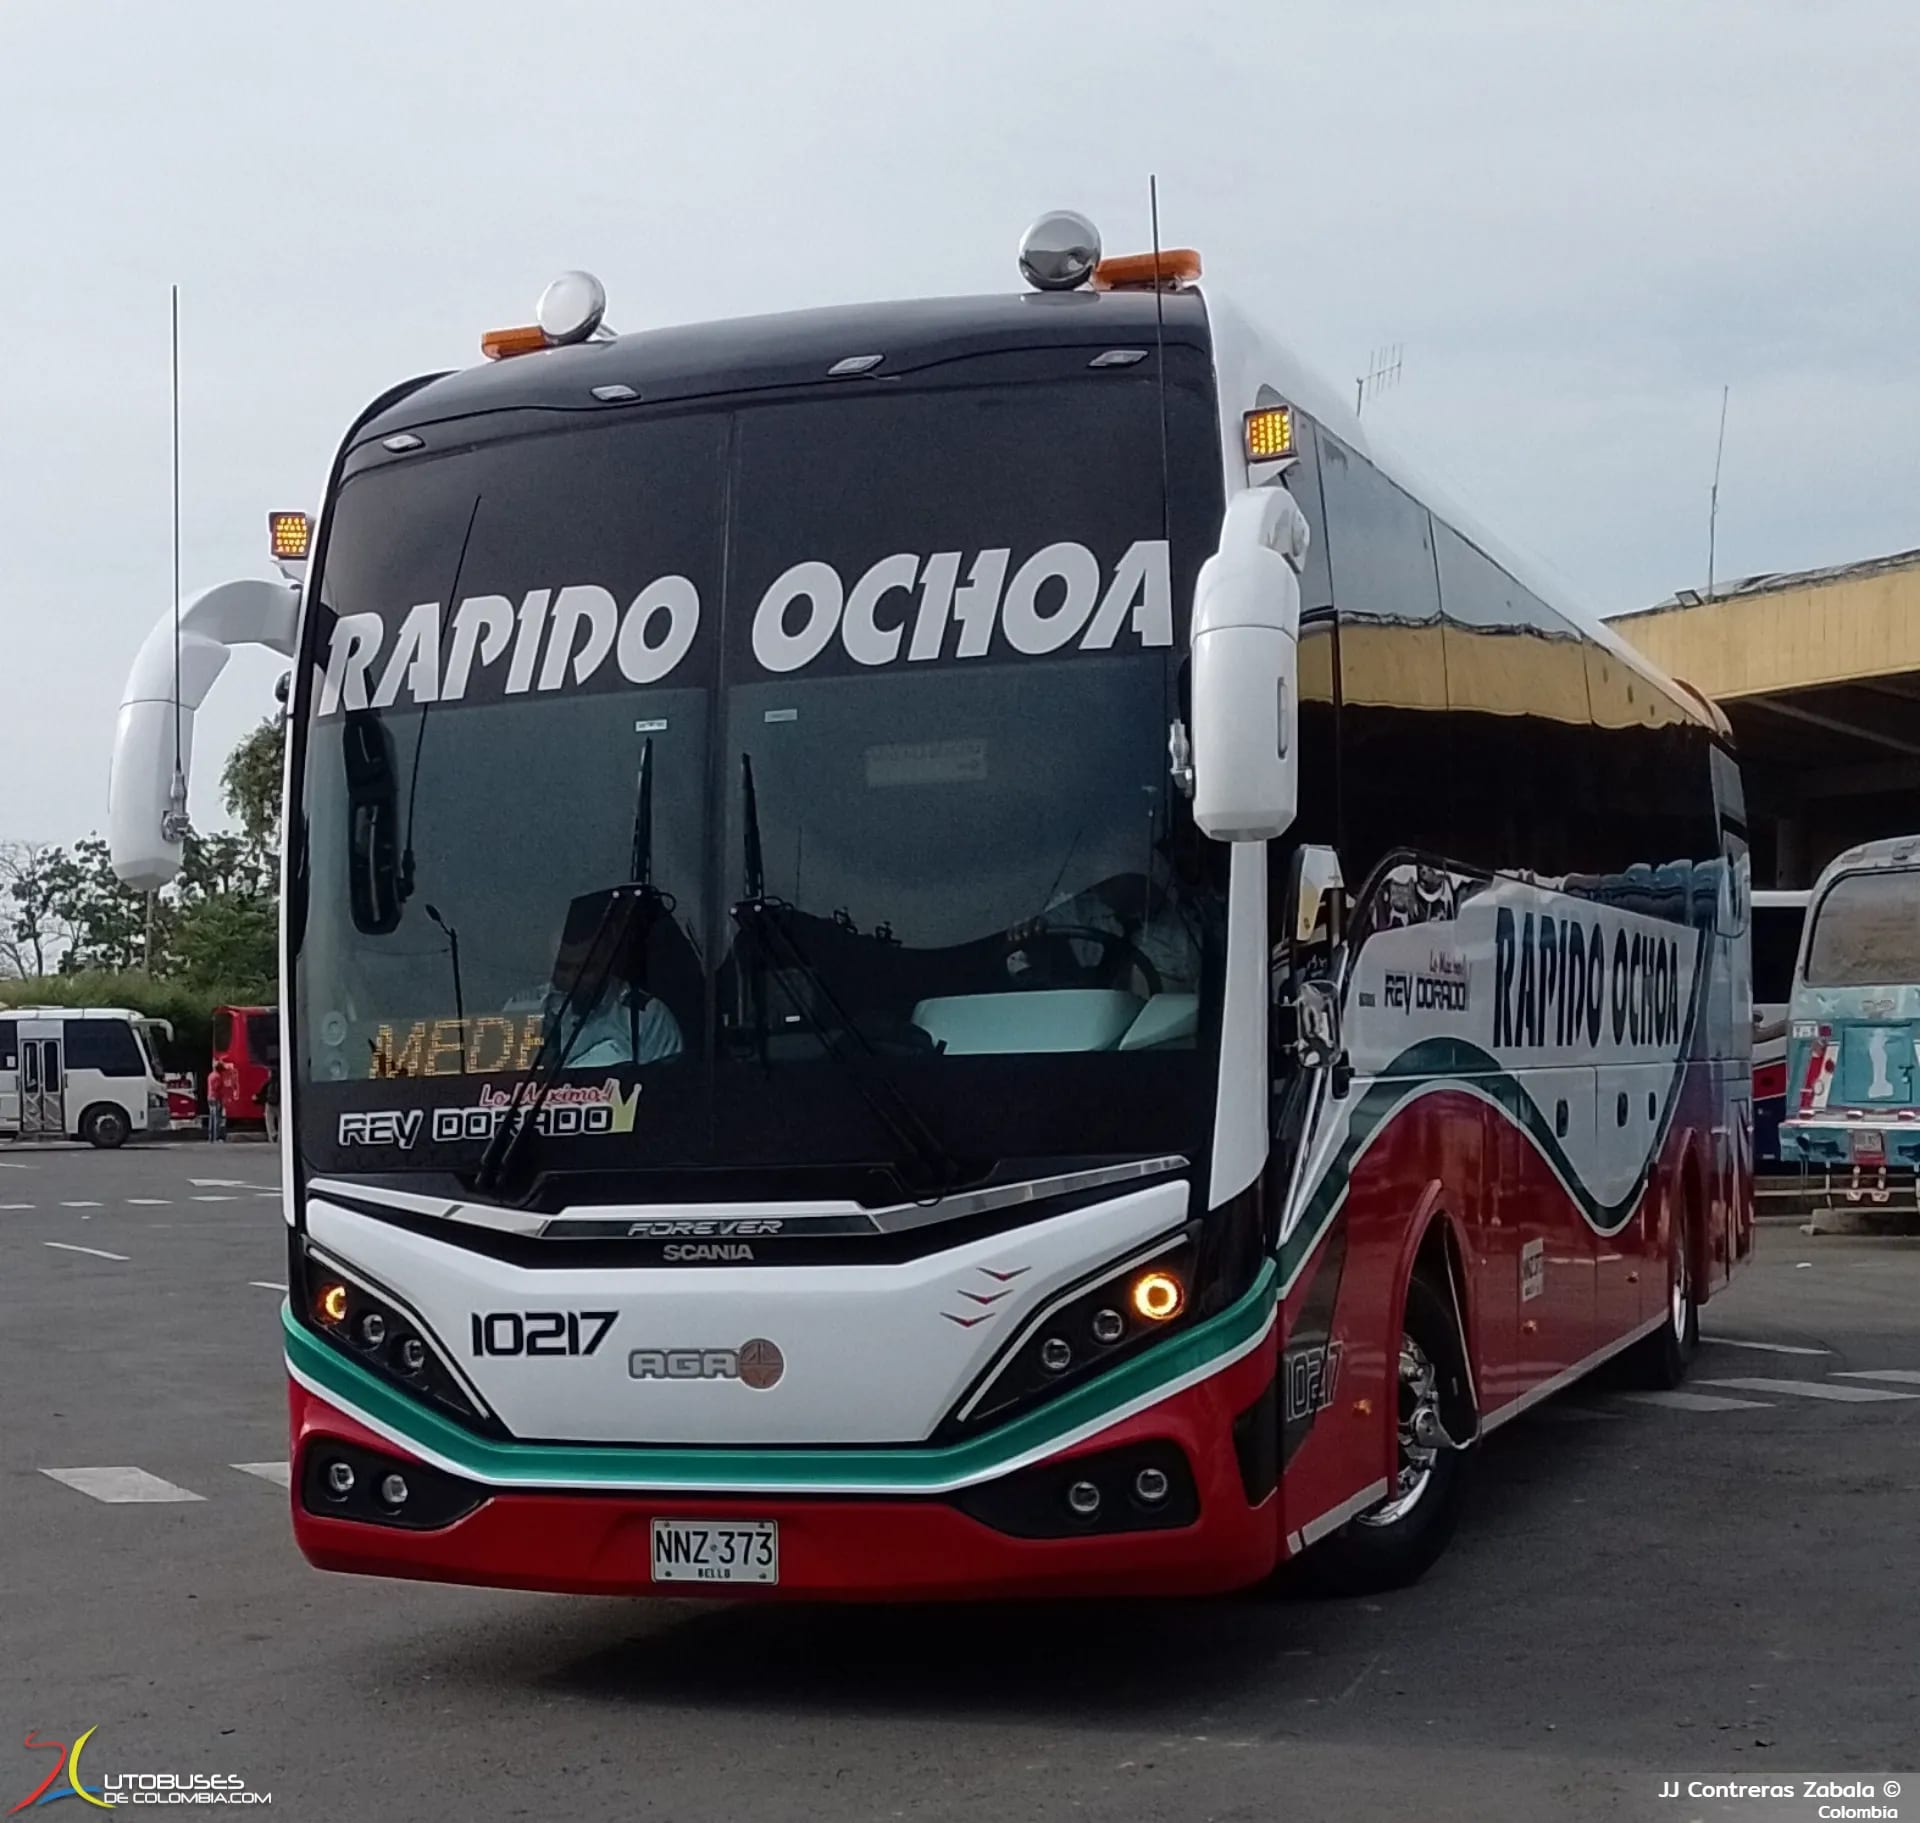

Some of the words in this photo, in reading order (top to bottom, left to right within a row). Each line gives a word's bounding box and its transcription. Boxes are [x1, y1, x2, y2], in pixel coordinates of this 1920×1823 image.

[317, 574, 701, 717] RAPIDO
[751, 540, 1174, 674] OCHOA
[1493, 906, 1605, 1048] RAPIDO
[1611, 927, 1679, 1048] OCHOA
[627, 1220, 784, 1236] FOREVER
[662, 1244, 754, 1261] SCANIA
[470, 1310, 619, 1357] 10217
[629, 1350, 740, 1379] AGA
[655, 1530, 709, 1564] NNZ
[718, 1531, 773, 1566] 373
